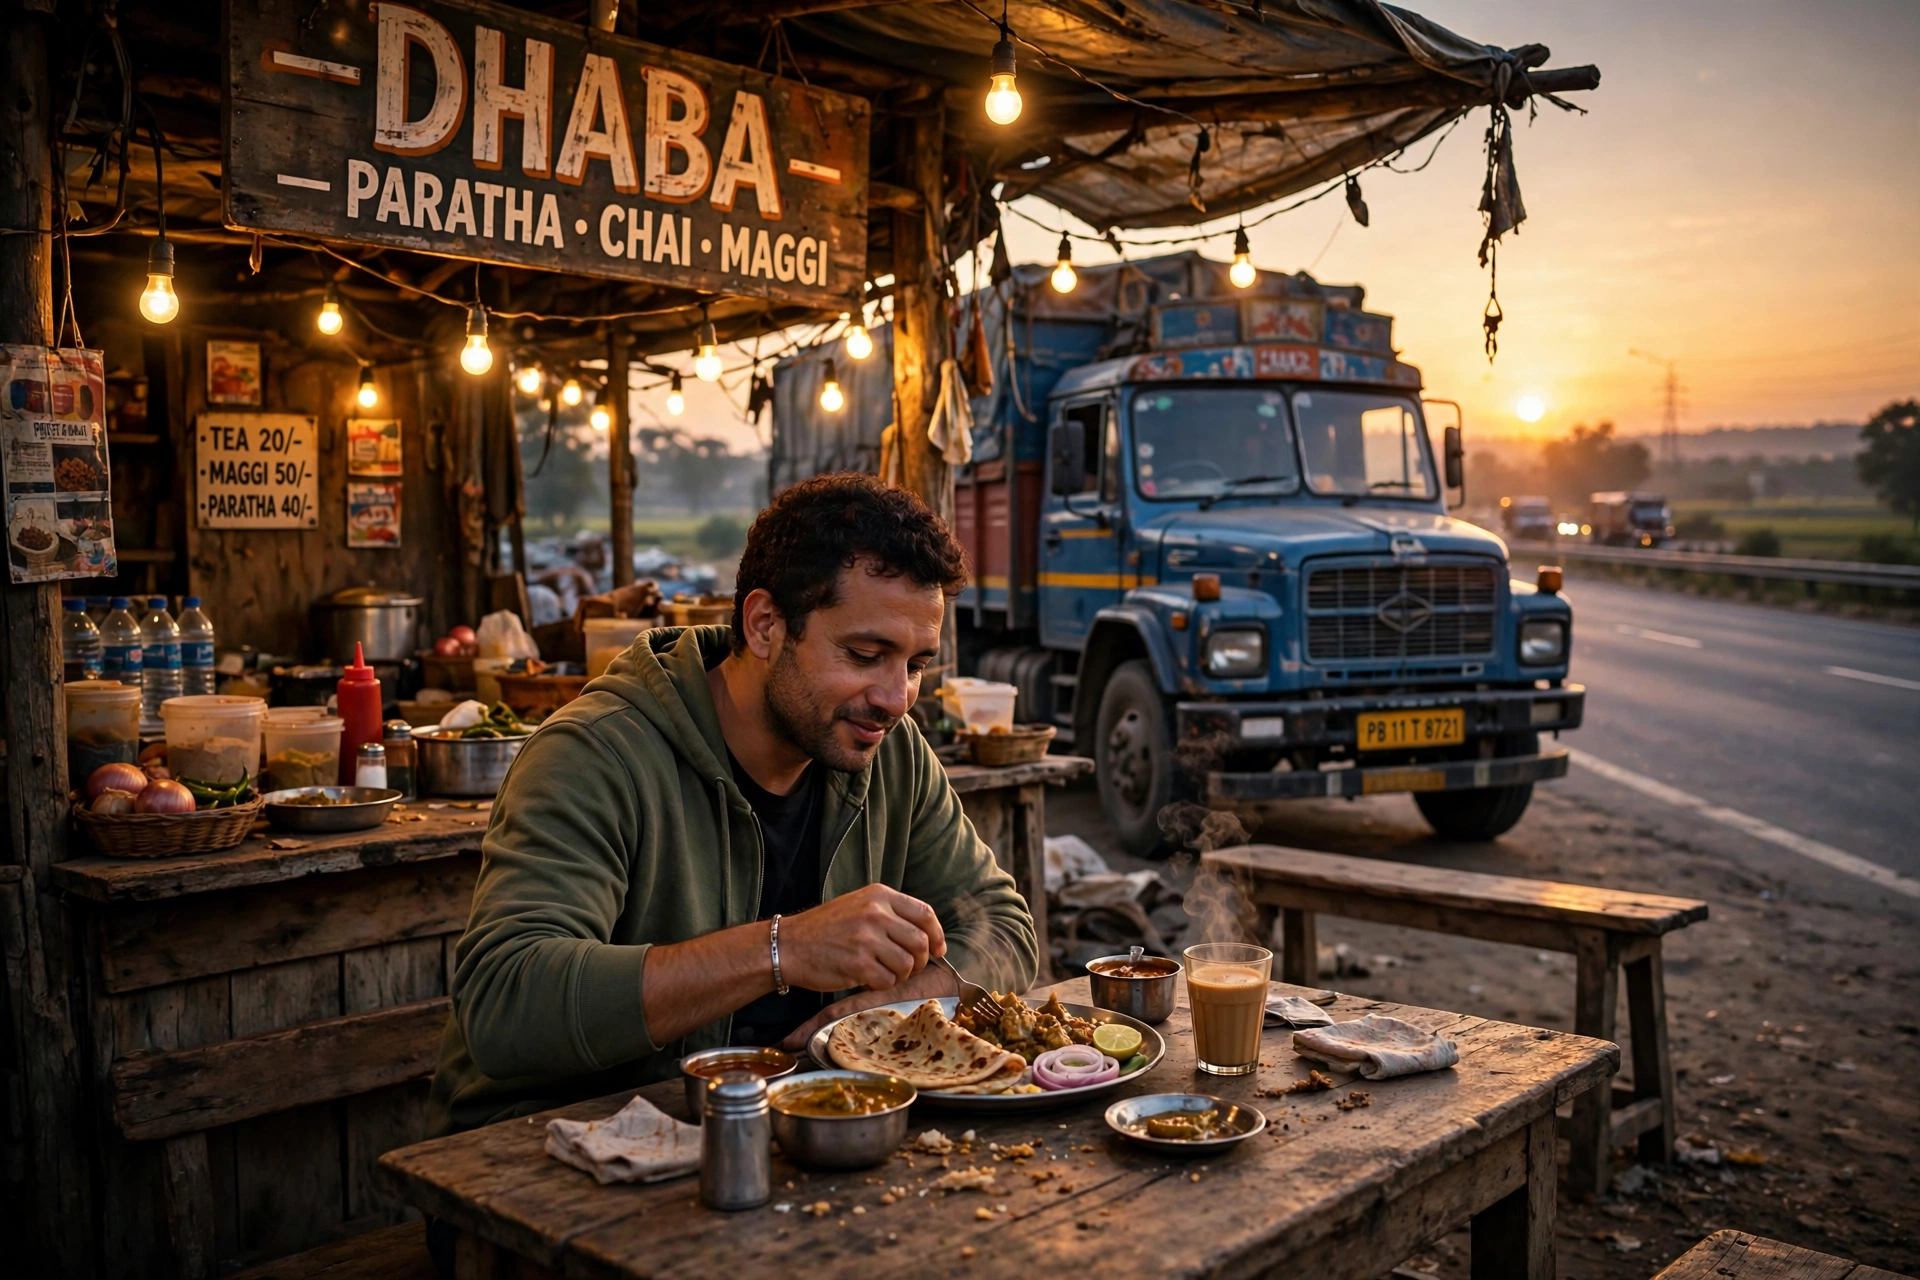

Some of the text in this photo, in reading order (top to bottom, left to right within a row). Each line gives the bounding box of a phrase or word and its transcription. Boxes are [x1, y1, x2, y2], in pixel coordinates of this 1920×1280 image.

[373, 2, 783, 221] DHABA
[346, 158, 828, 287] PARATHA CHAI MAGGI
[209, 426, 302, 455] TEA 20/-
[209, 460, 312, 488] MAGGI 50/-
[208, 493, 312, 520] PARATHA 40/-
[1367, 717, 1459, 742] PB 11 T 8721
